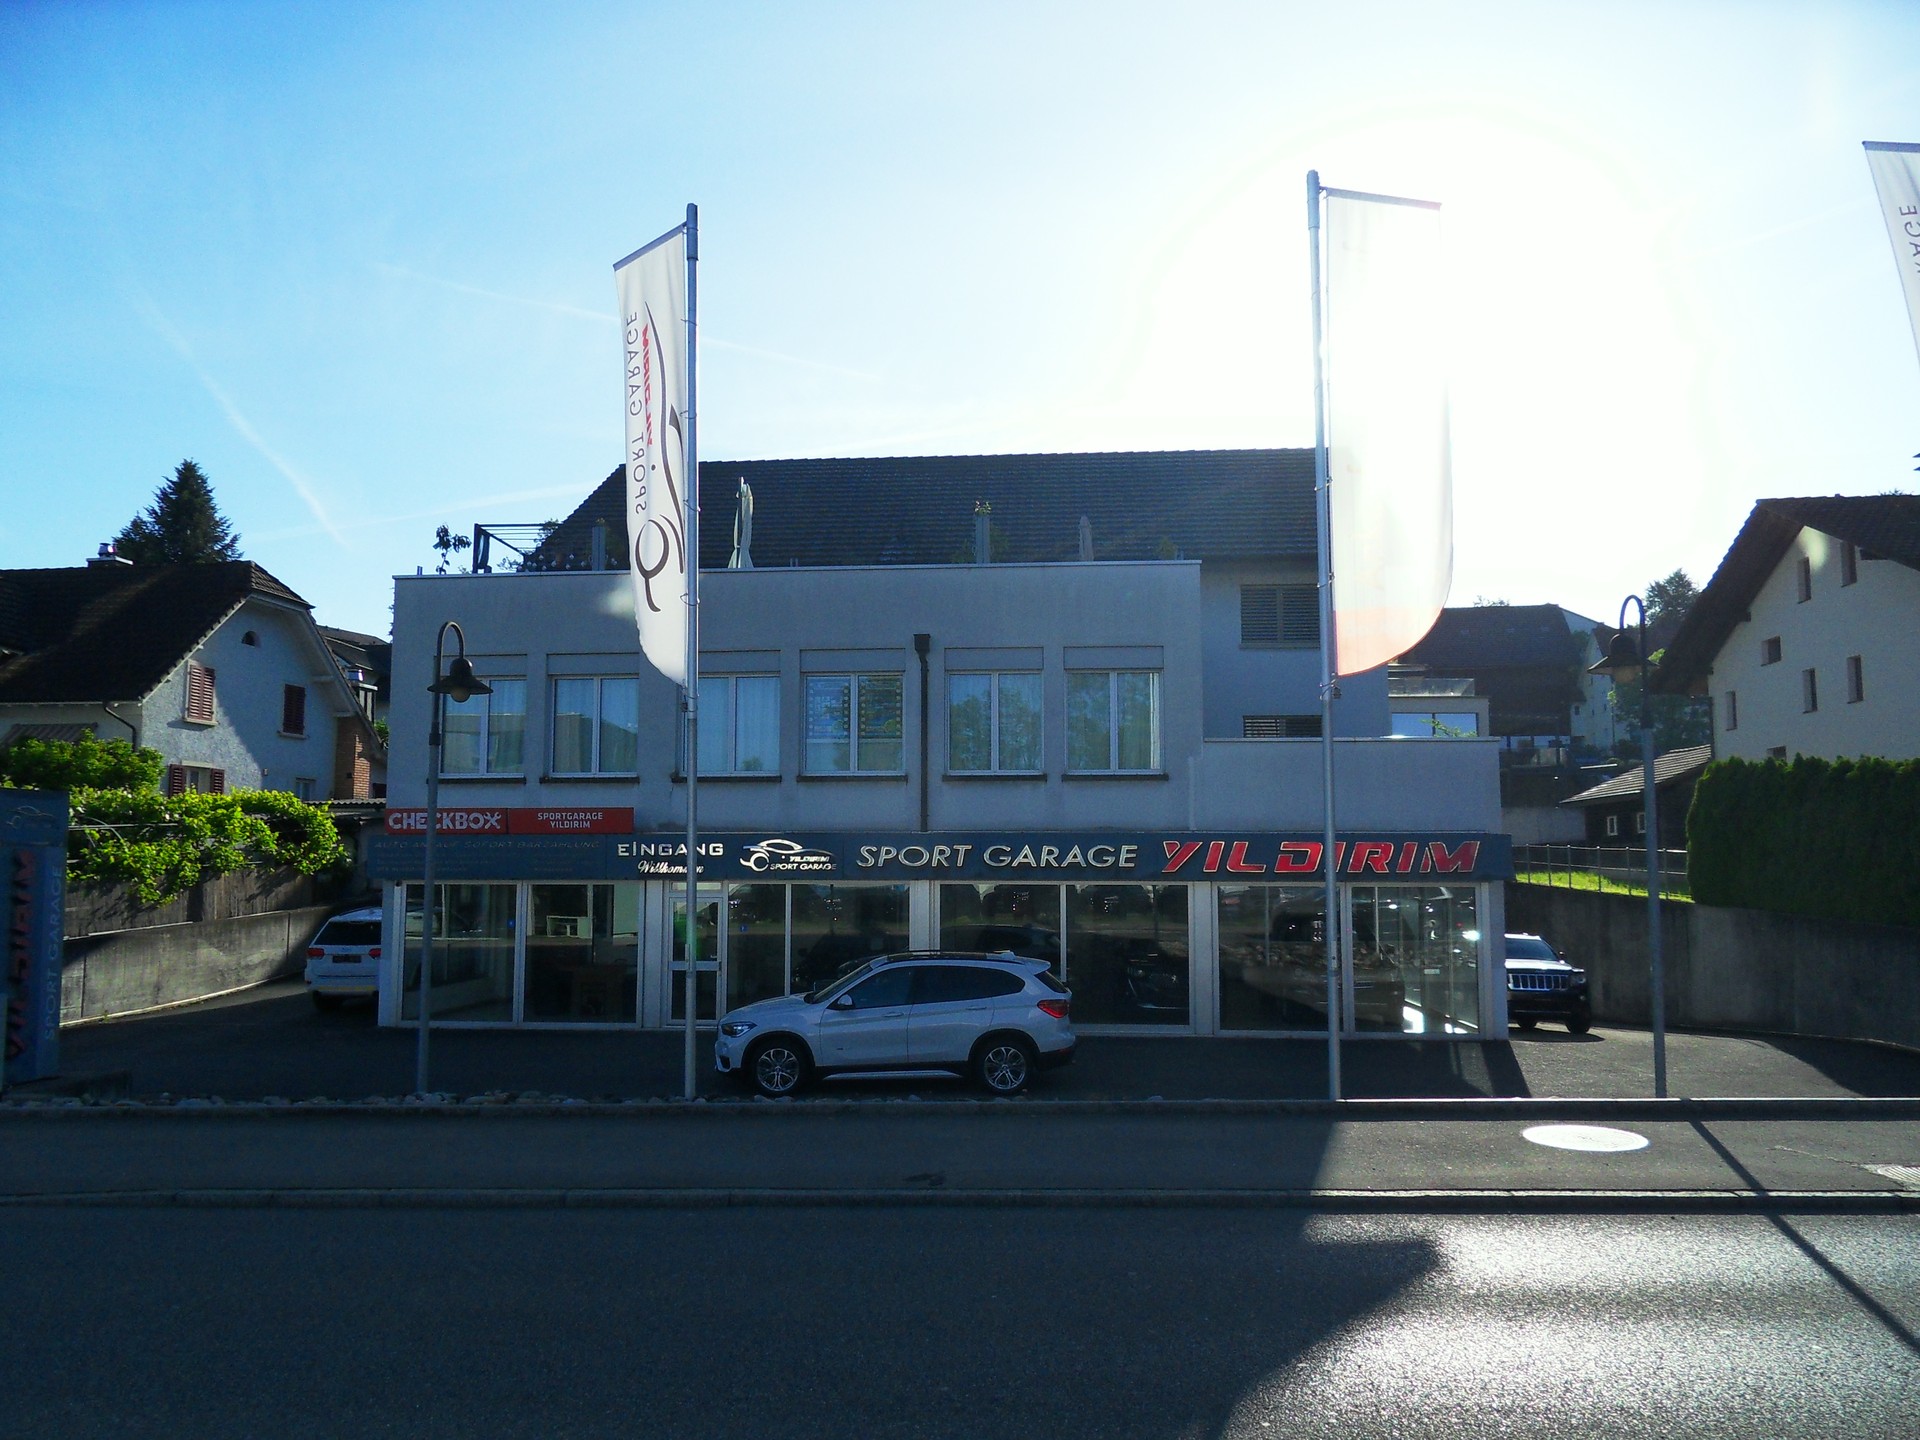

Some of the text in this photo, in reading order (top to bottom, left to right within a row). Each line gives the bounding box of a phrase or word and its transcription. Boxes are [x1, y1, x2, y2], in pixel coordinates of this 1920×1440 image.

[537, 812, 604, 820] SPORTGARAGE
[550, 820, 591, 828] YILDIRIM
[617, 841, 724, 856] EINGANG
[856, 845, 1138, 867] SPORT GARAGE
[1162, 840, 1481, 873] YILDIRIM
[44, 865, 62, 1041] SPORT GARAGE
